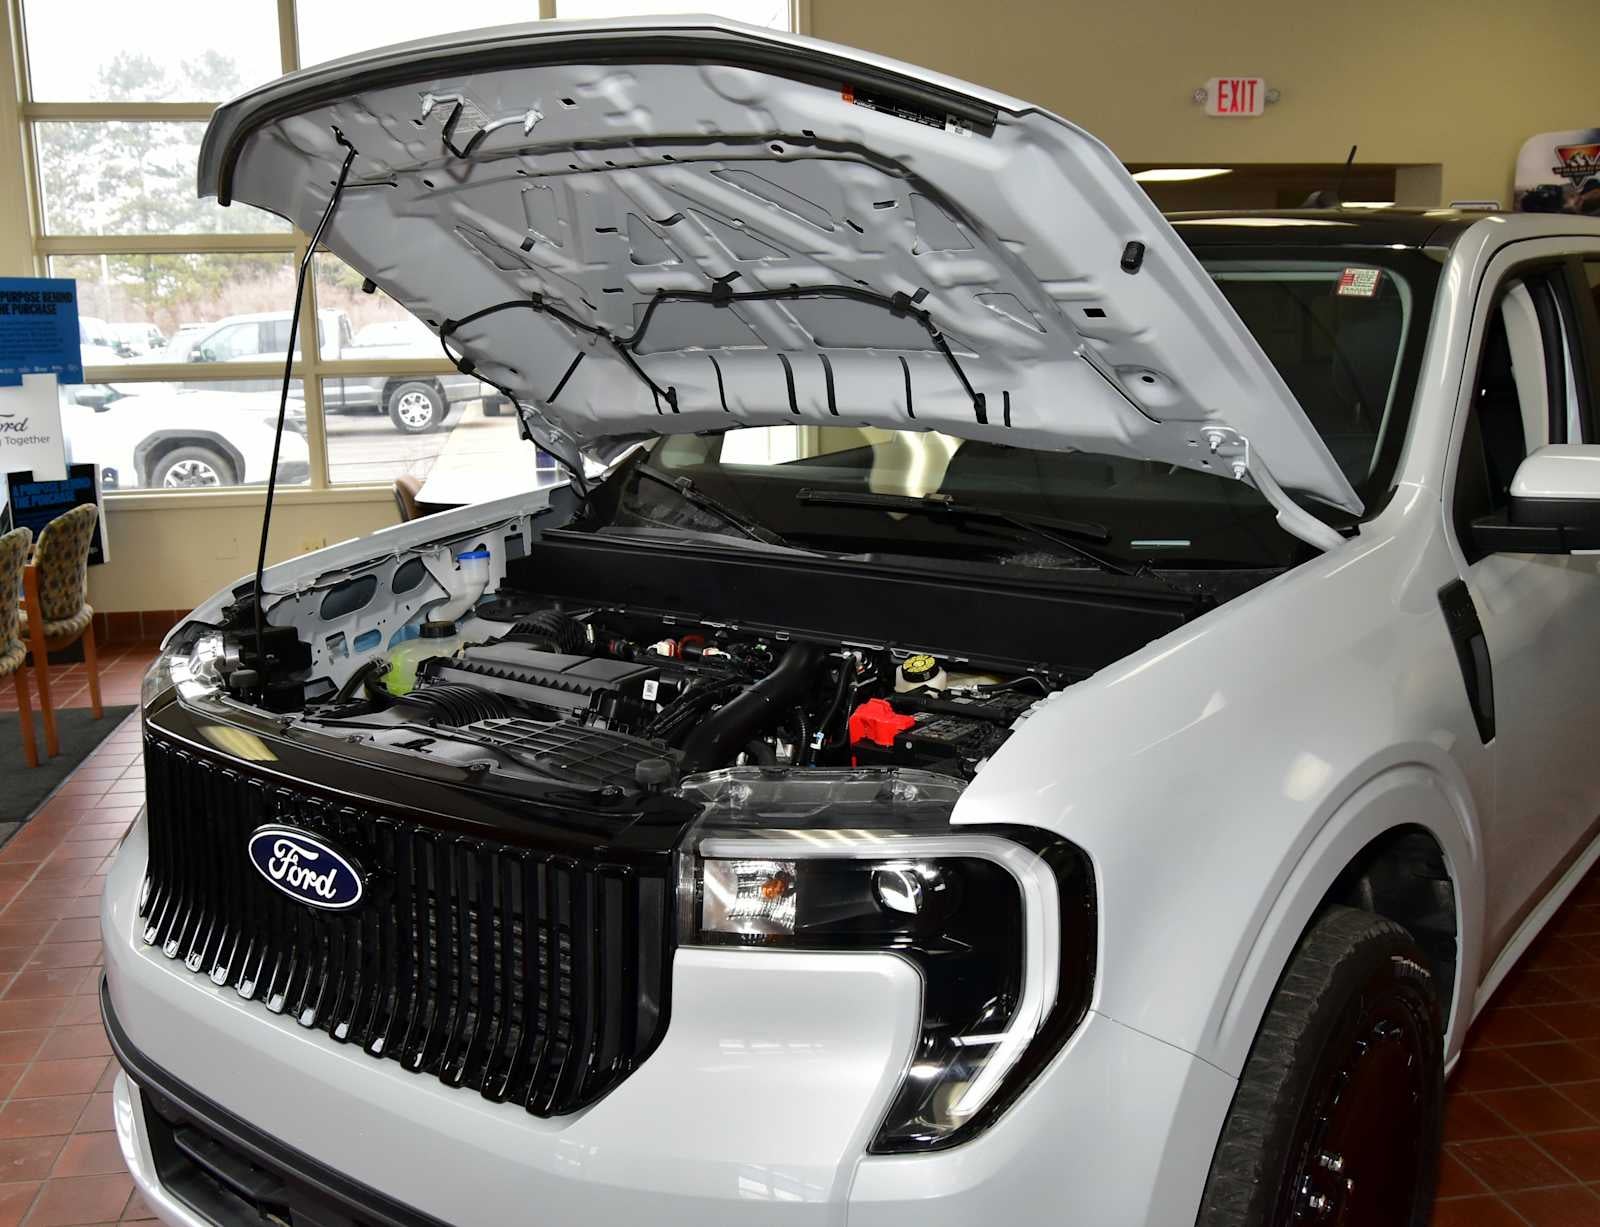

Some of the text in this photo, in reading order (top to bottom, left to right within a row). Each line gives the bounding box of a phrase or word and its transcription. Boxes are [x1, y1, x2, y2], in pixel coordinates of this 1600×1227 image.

[1218, 79, 1257, 112] EXIT
[12, 303, 57, 315] PURCHASE
[5, 435, 50, 447] Together
[268, 838, 338, 899] Ford
